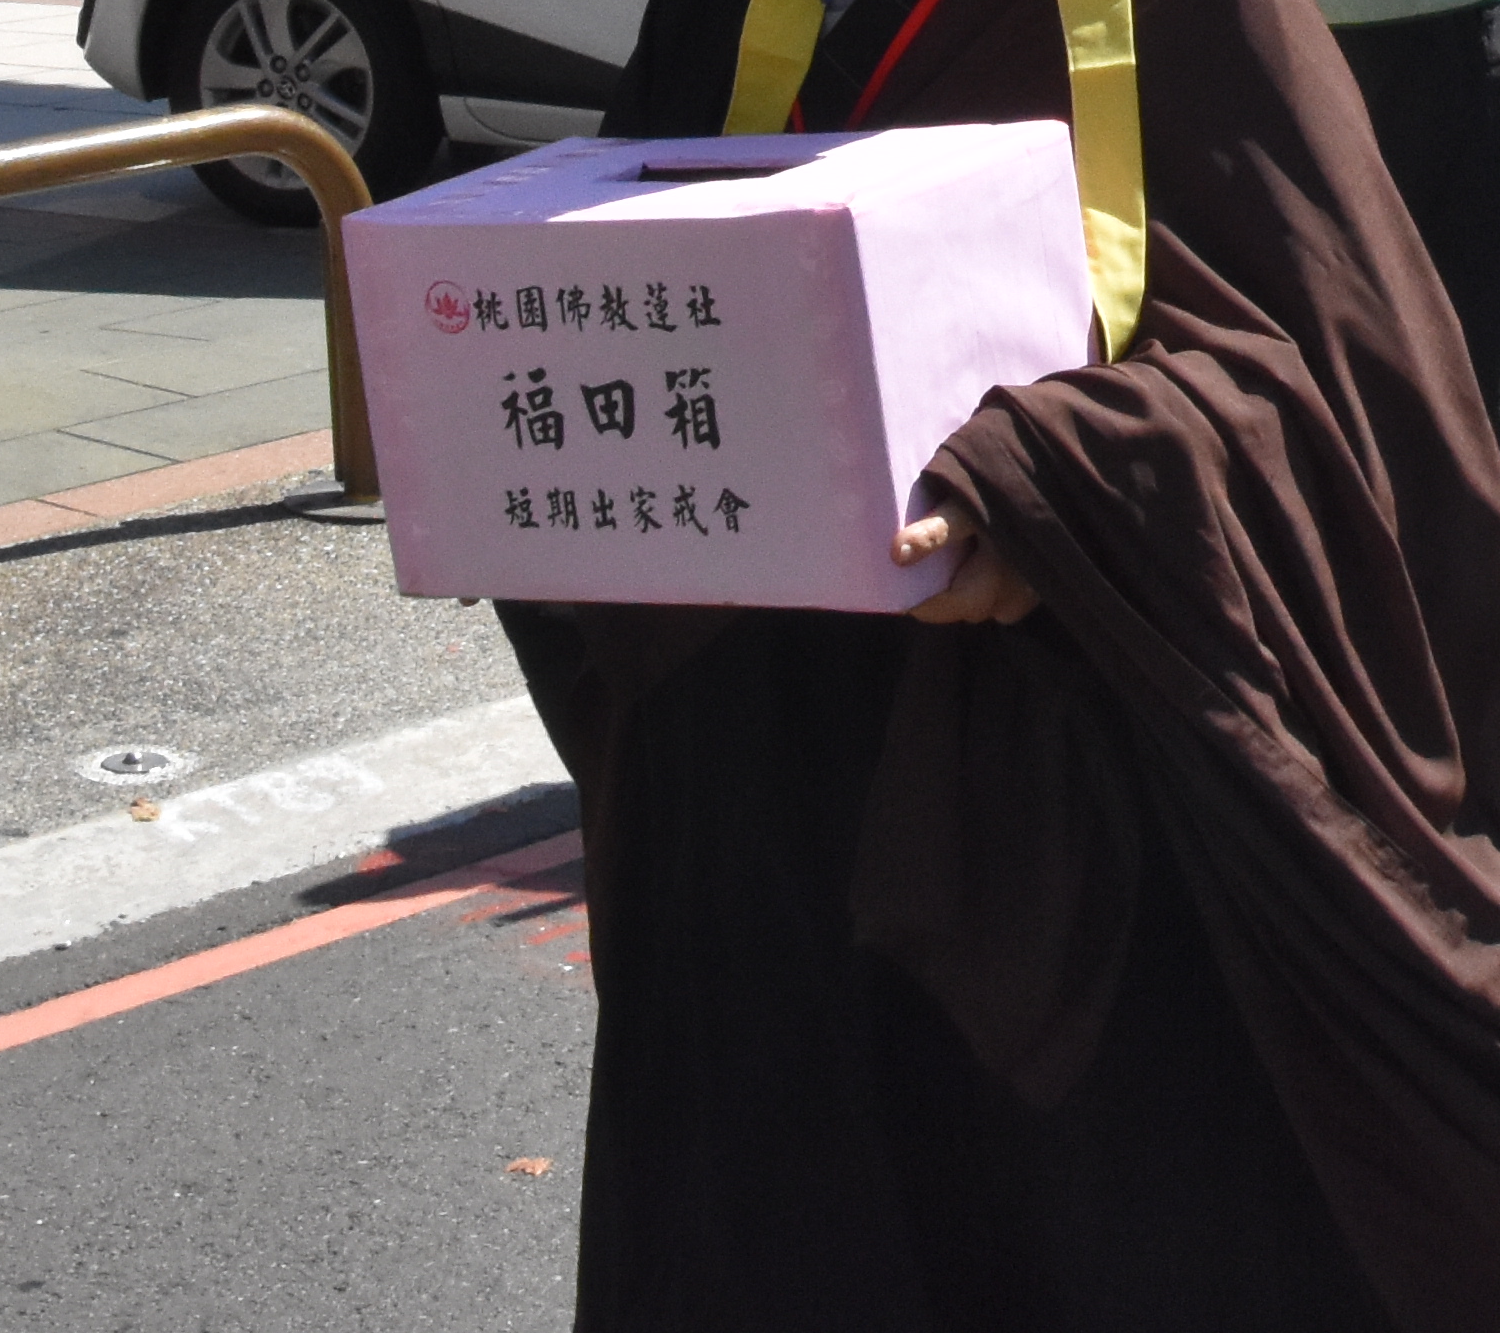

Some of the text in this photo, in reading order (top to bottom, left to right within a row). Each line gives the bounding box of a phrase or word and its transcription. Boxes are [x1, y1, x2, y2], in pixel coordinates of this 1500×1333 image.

[472, 283, 723, 334] 桃園佛教蓮社
[499, 366, 723, 451] 福田箱
[503, 484, 752, 538] 短期出家戒會
